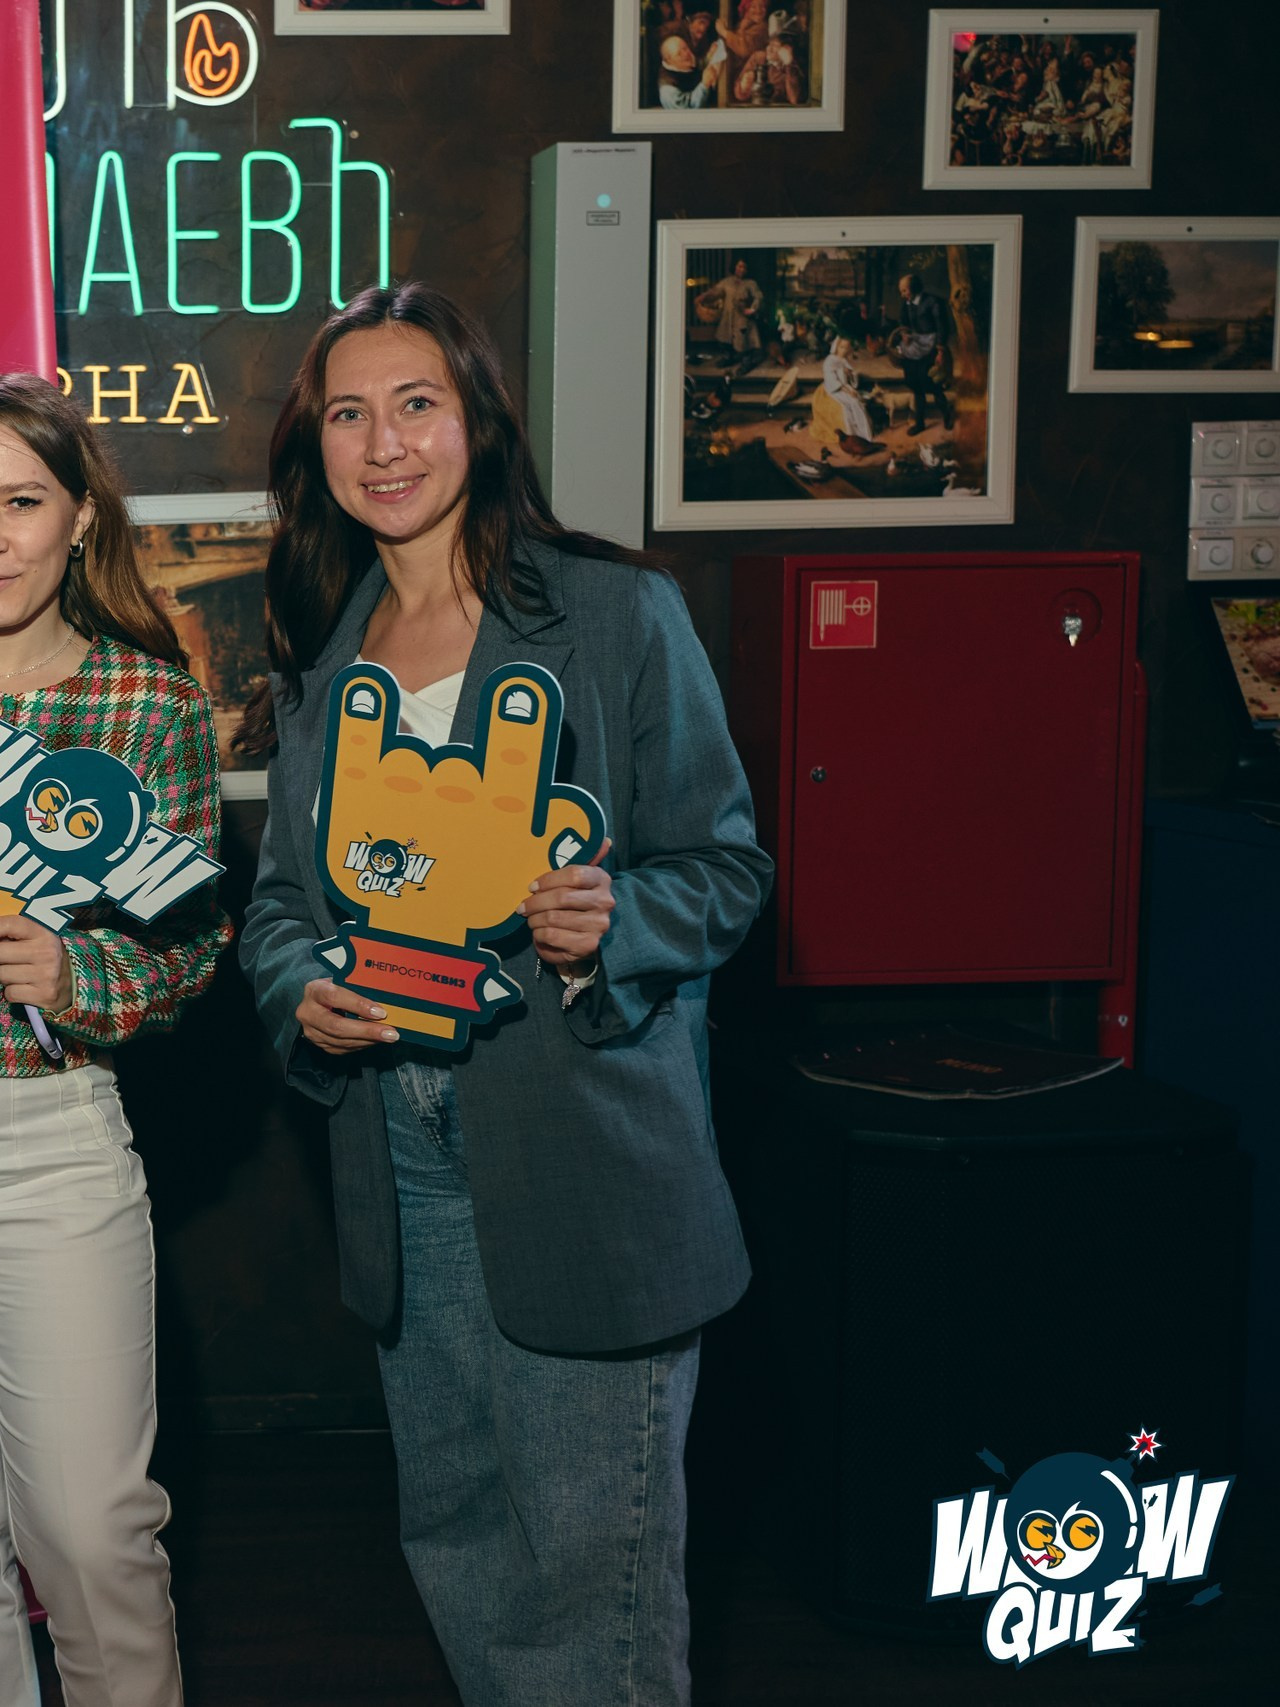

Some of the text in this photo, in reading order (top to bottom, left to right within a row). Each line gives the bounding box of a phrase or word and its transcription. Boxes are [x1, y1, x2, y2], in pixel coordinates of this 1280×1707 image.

[45, 117, 391, 316] АЕВЪ
[56, 362, 221, 424] НА
[356, 870, 405, 898] QUIZ
[364, 958, 467, 989] #НЕПРОСТОКВИЗ
